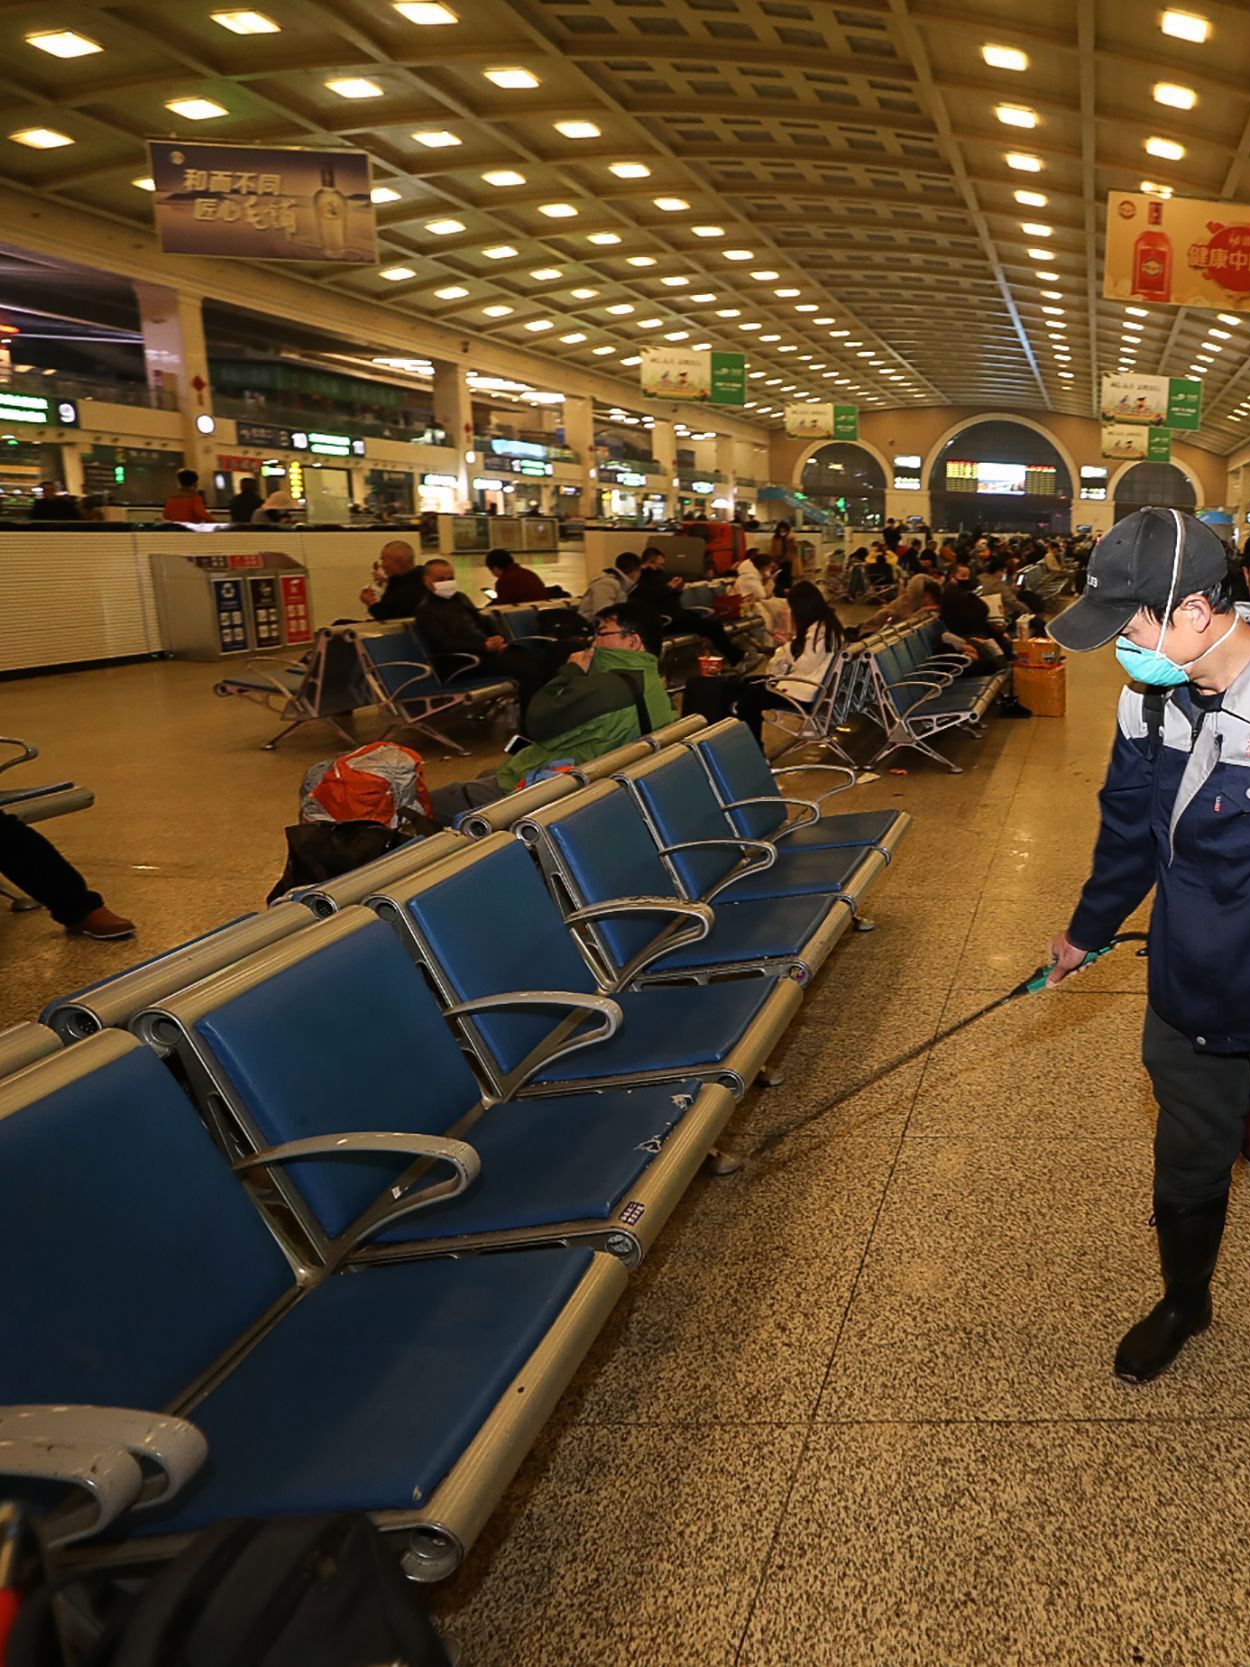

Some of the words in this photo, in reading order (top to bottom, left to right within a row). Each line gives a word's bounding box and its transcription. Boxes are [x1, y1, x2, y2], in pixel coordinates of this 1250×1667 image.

[183, 168, 282, 196] 和而不同
[58, 403, 76, 423] 9
